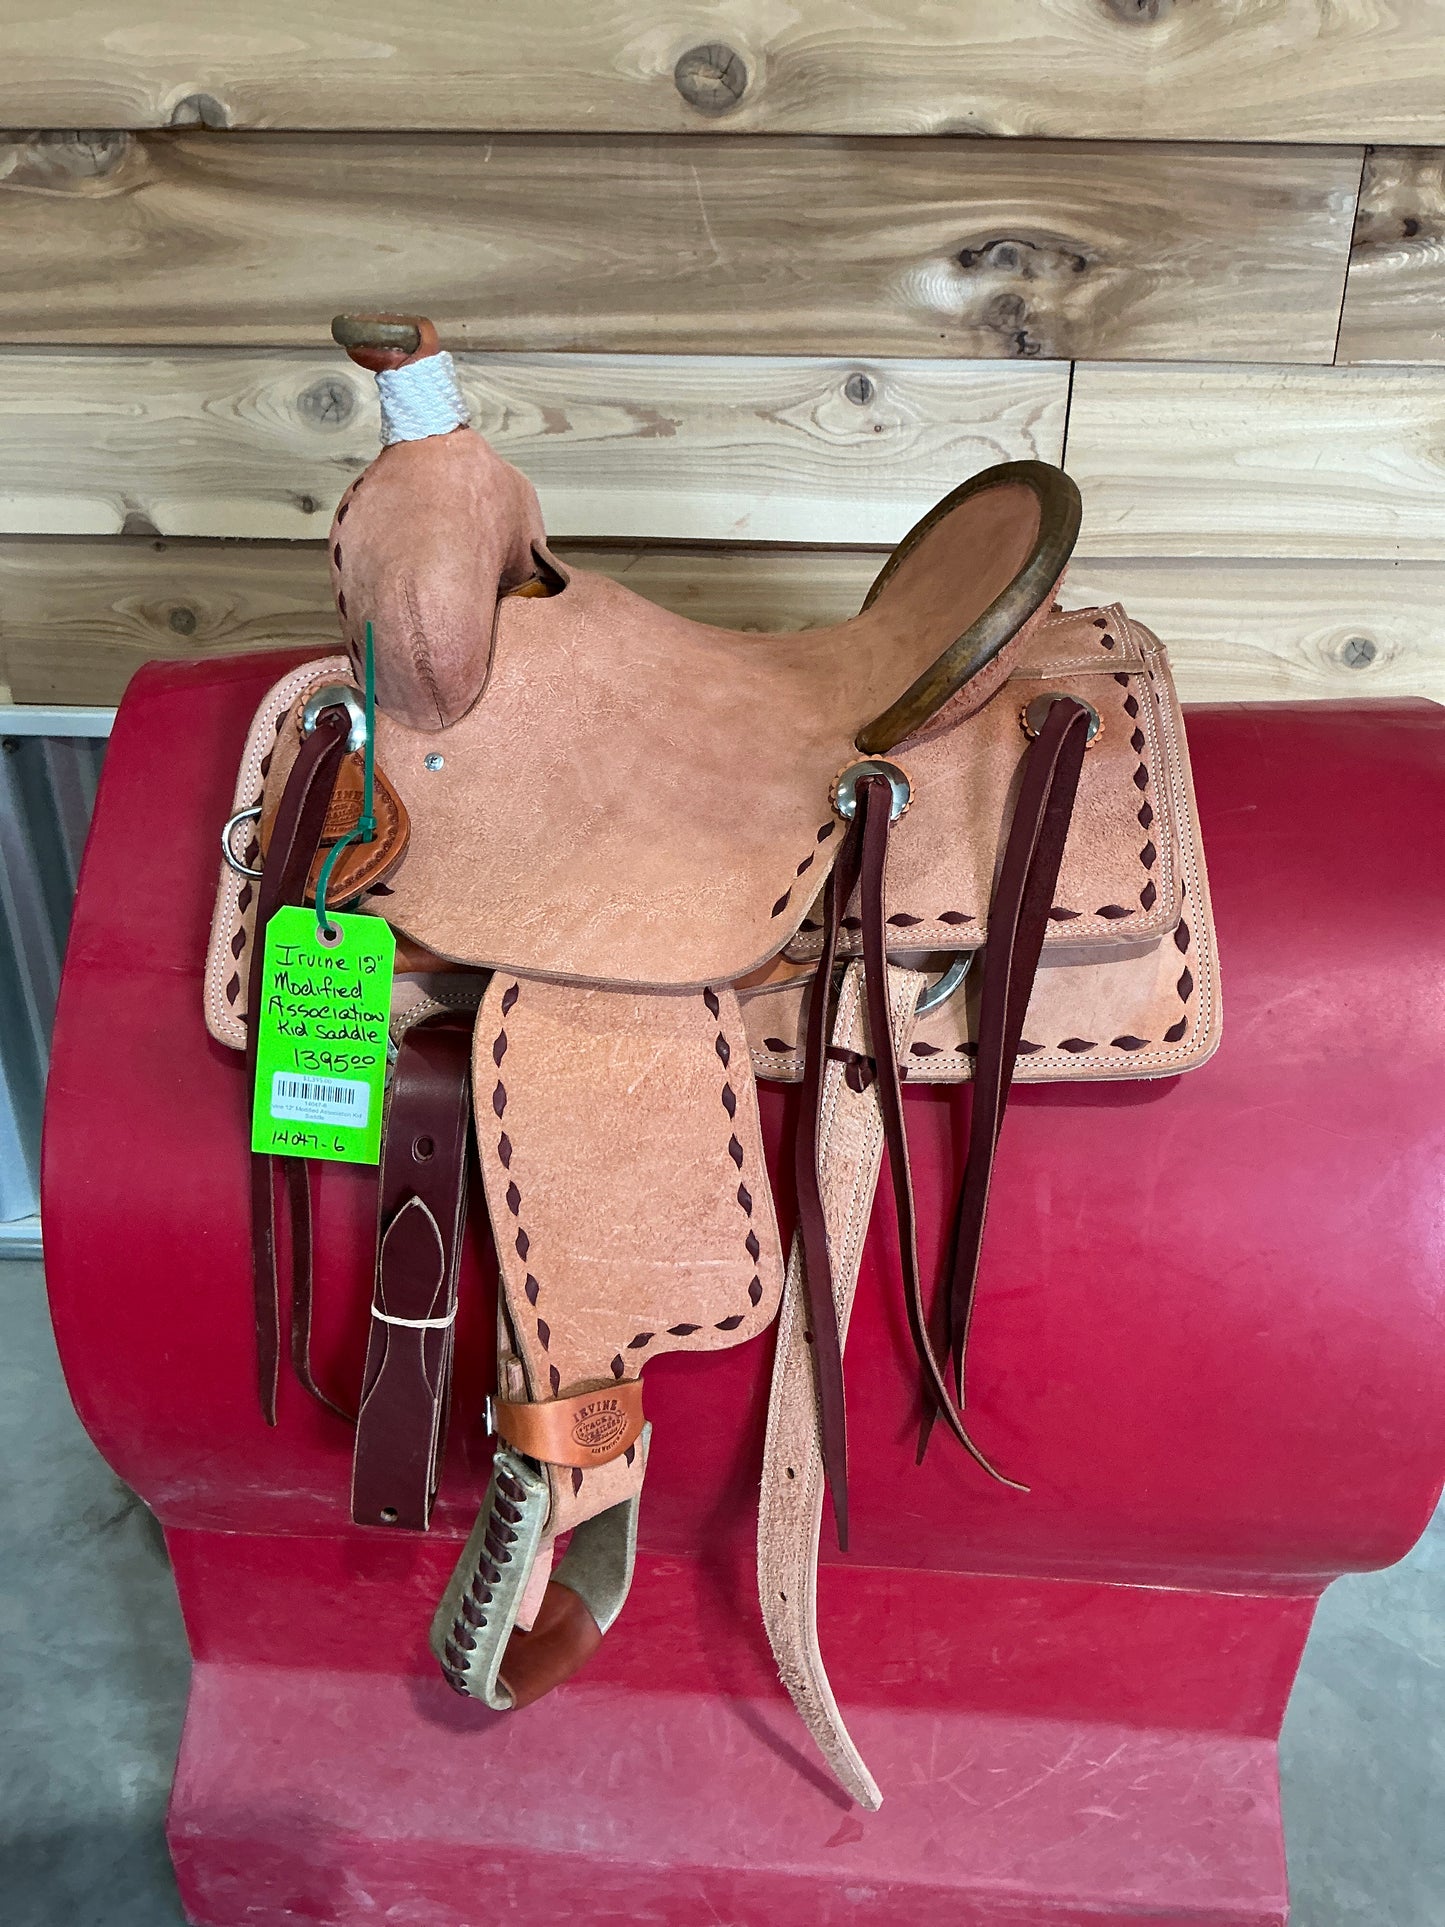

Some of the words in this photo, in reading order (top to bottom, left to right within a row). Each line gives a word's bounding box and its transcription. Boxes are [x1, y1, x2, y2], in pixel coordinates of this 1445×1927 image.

[275, 944, 350, 971] Irvine
[358, 954, 383, 974] 12"
[274, 970, 363, 999] Modified
[268, 995, 385, 1023] Association
[277, 1019, 309, 1037] Kid
[315, 1024, 383, 1044] Saddle
[573, 1399, 618, 1423] IRVINE
